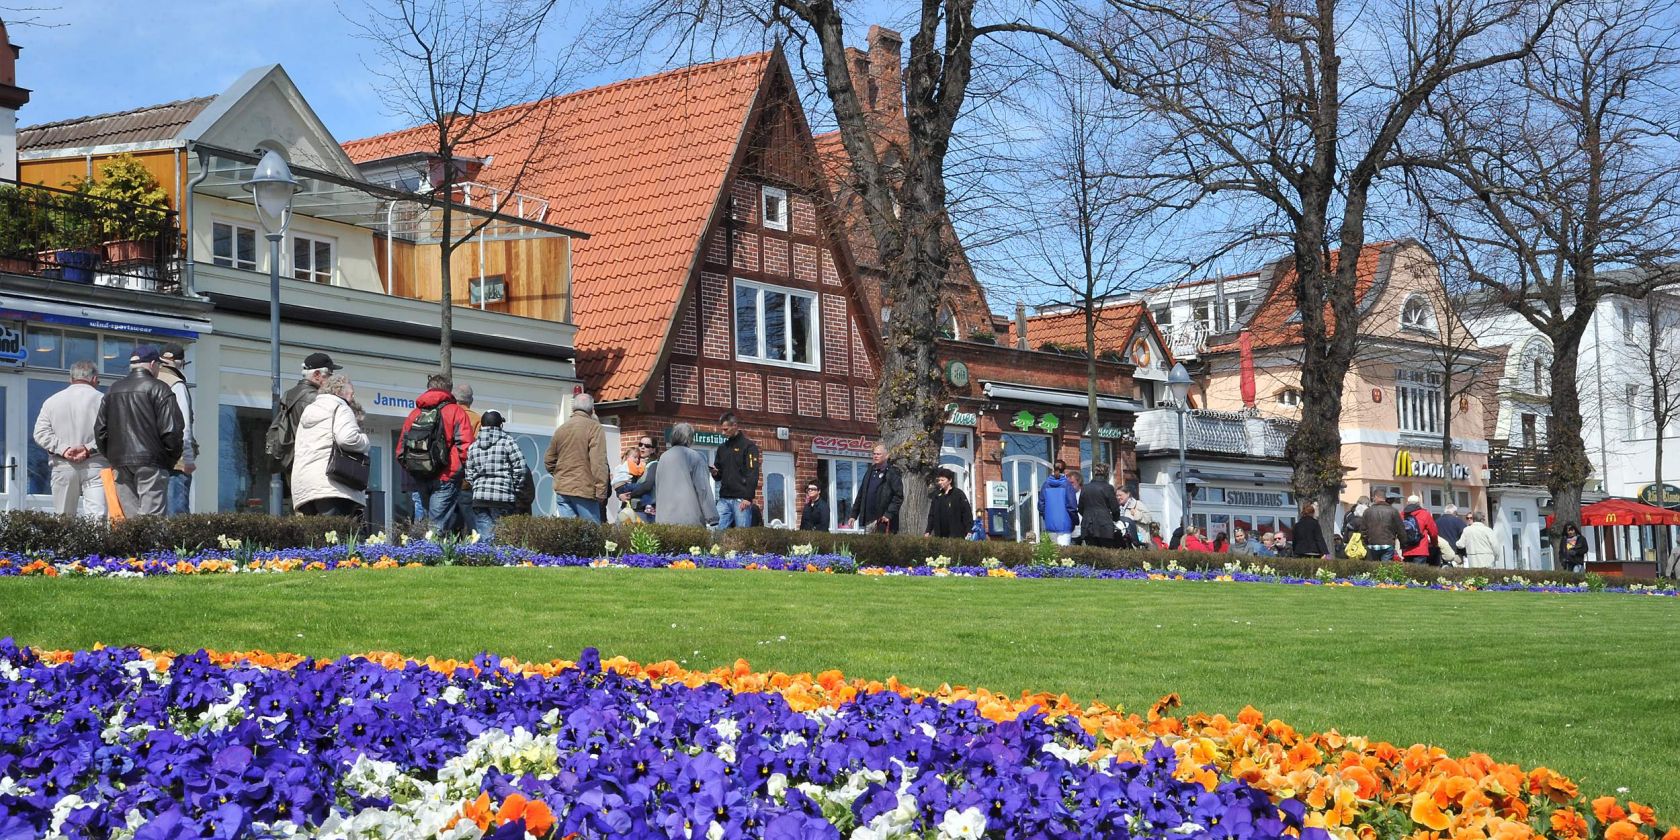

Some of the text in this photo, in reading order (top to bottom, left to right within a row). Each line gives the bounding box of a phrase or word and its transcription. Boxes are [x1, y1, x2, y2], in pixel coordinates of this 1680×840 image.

[374, 392, 416, 409] Janma
[1395, 450, 1470, 479] McDonld's
[1227, 490, 1283, 507] STAHLHAUS
